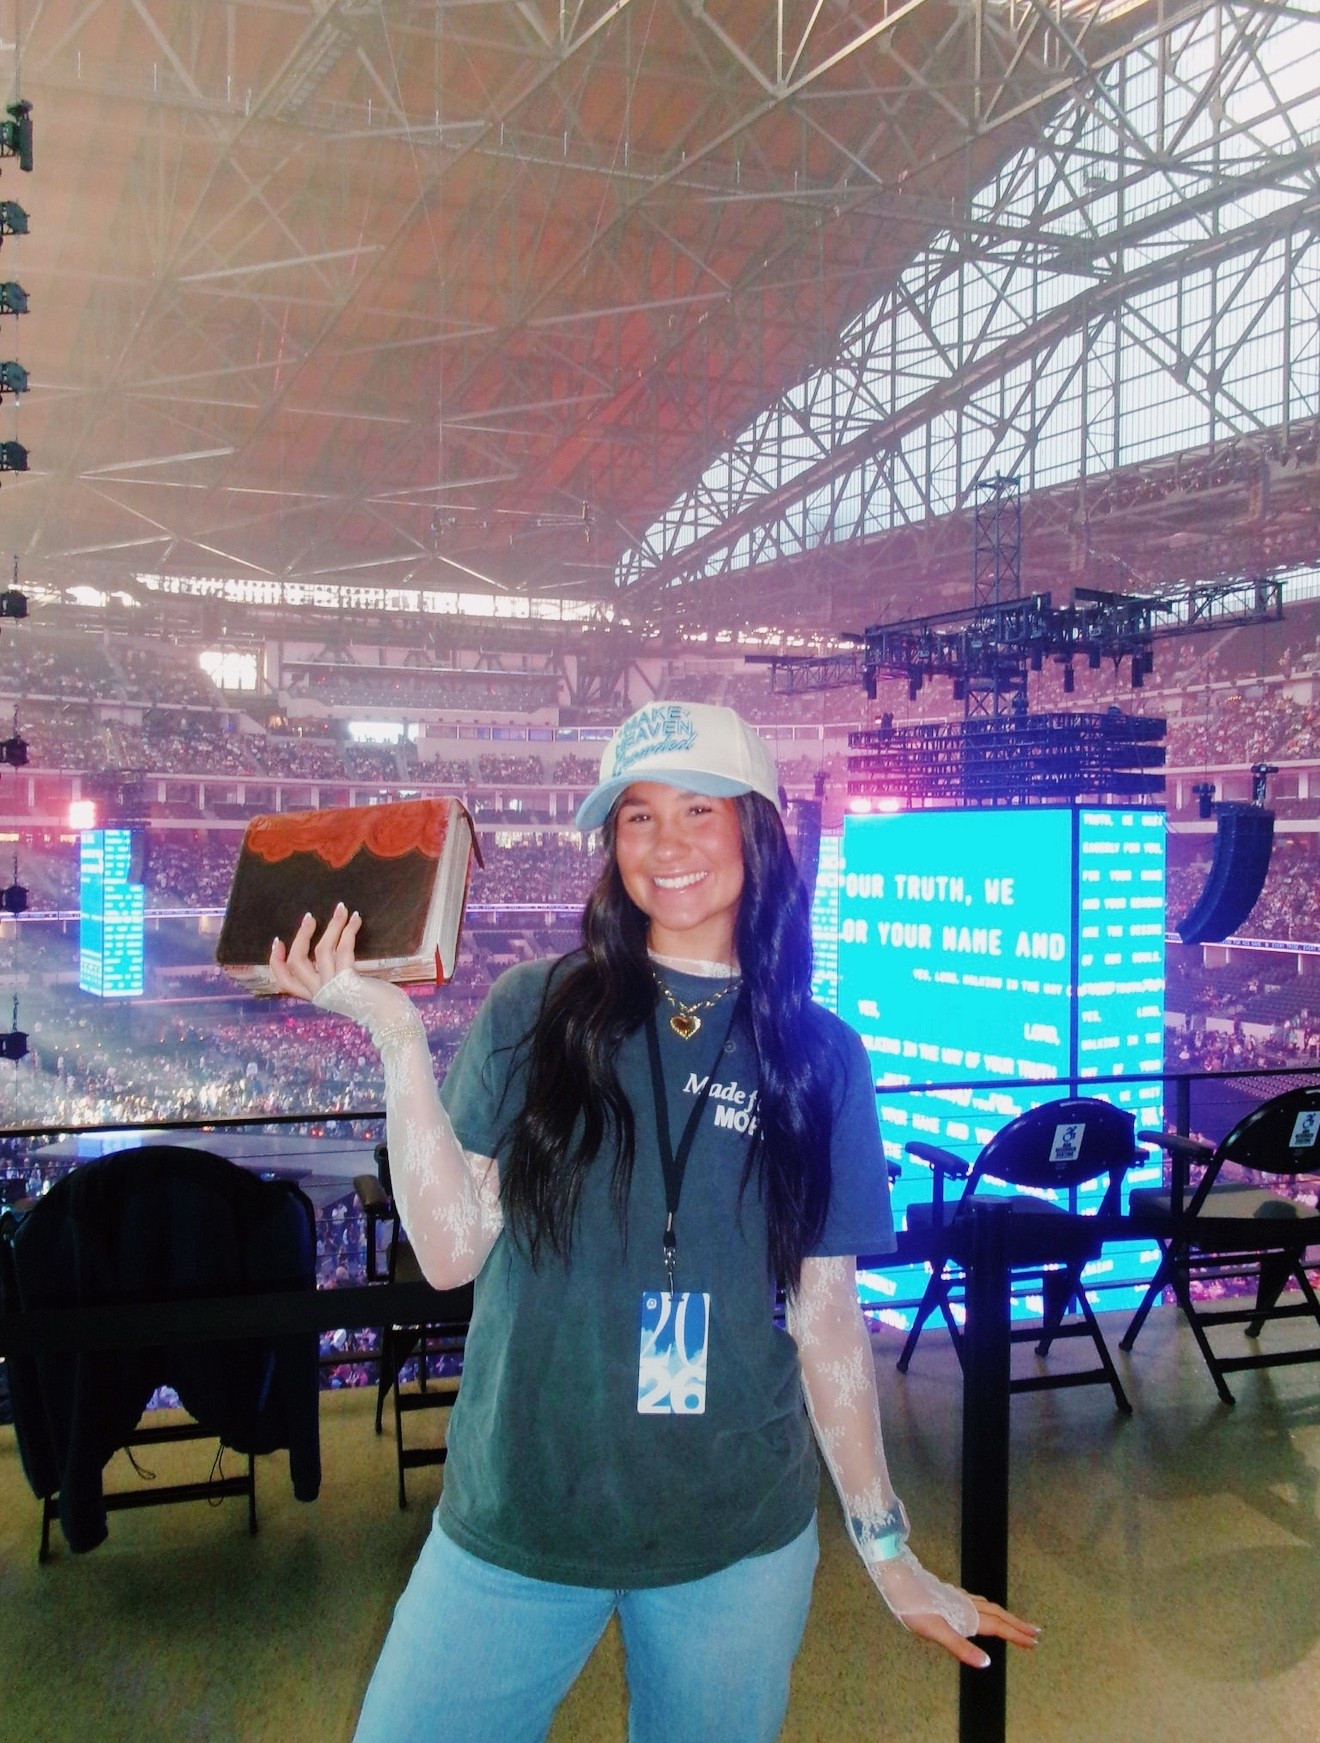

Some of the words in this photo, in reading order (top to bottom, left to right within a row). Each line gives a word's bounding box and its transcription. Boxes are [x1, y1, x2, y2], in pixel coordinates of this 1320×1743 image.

[844, 872, 885, 899] OUR
[894, 874, 972, 907] TRUTH,
[984, 877, 1015, 906] WE
[840, 918, 869, 944] OR
[878, 921, 932, 950] YOUR
[942, 926, 1003, 956] NAME
[1015, 931, 1066, 961] AND
[682, 1073, 746, 1104] Made
[714, 1104, 765, 1141] MO
